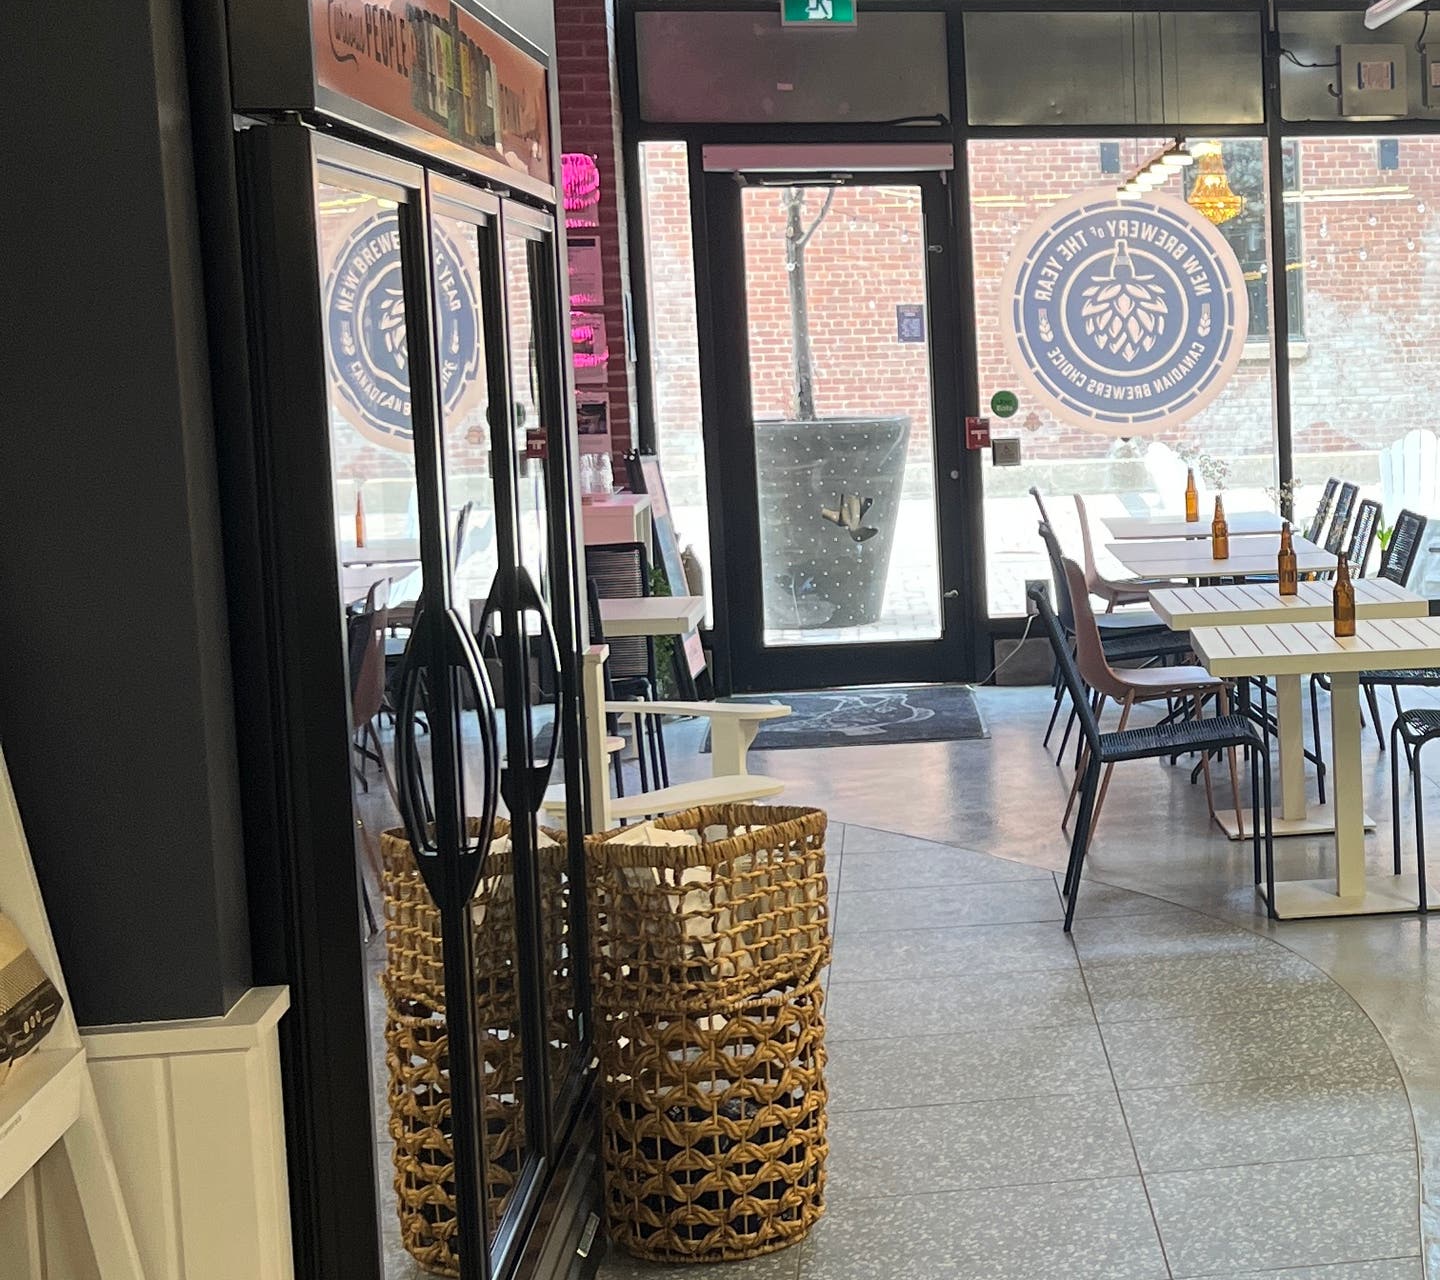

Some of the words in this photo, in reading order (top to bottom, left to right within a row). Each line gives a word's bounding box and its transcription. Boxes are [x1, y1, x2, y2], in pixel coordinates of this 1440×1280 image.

[364, 3, 409, 78] PEOPLE
[337, 263, 361, 313] NEW
[355, 230, 401, 271] BREWE
